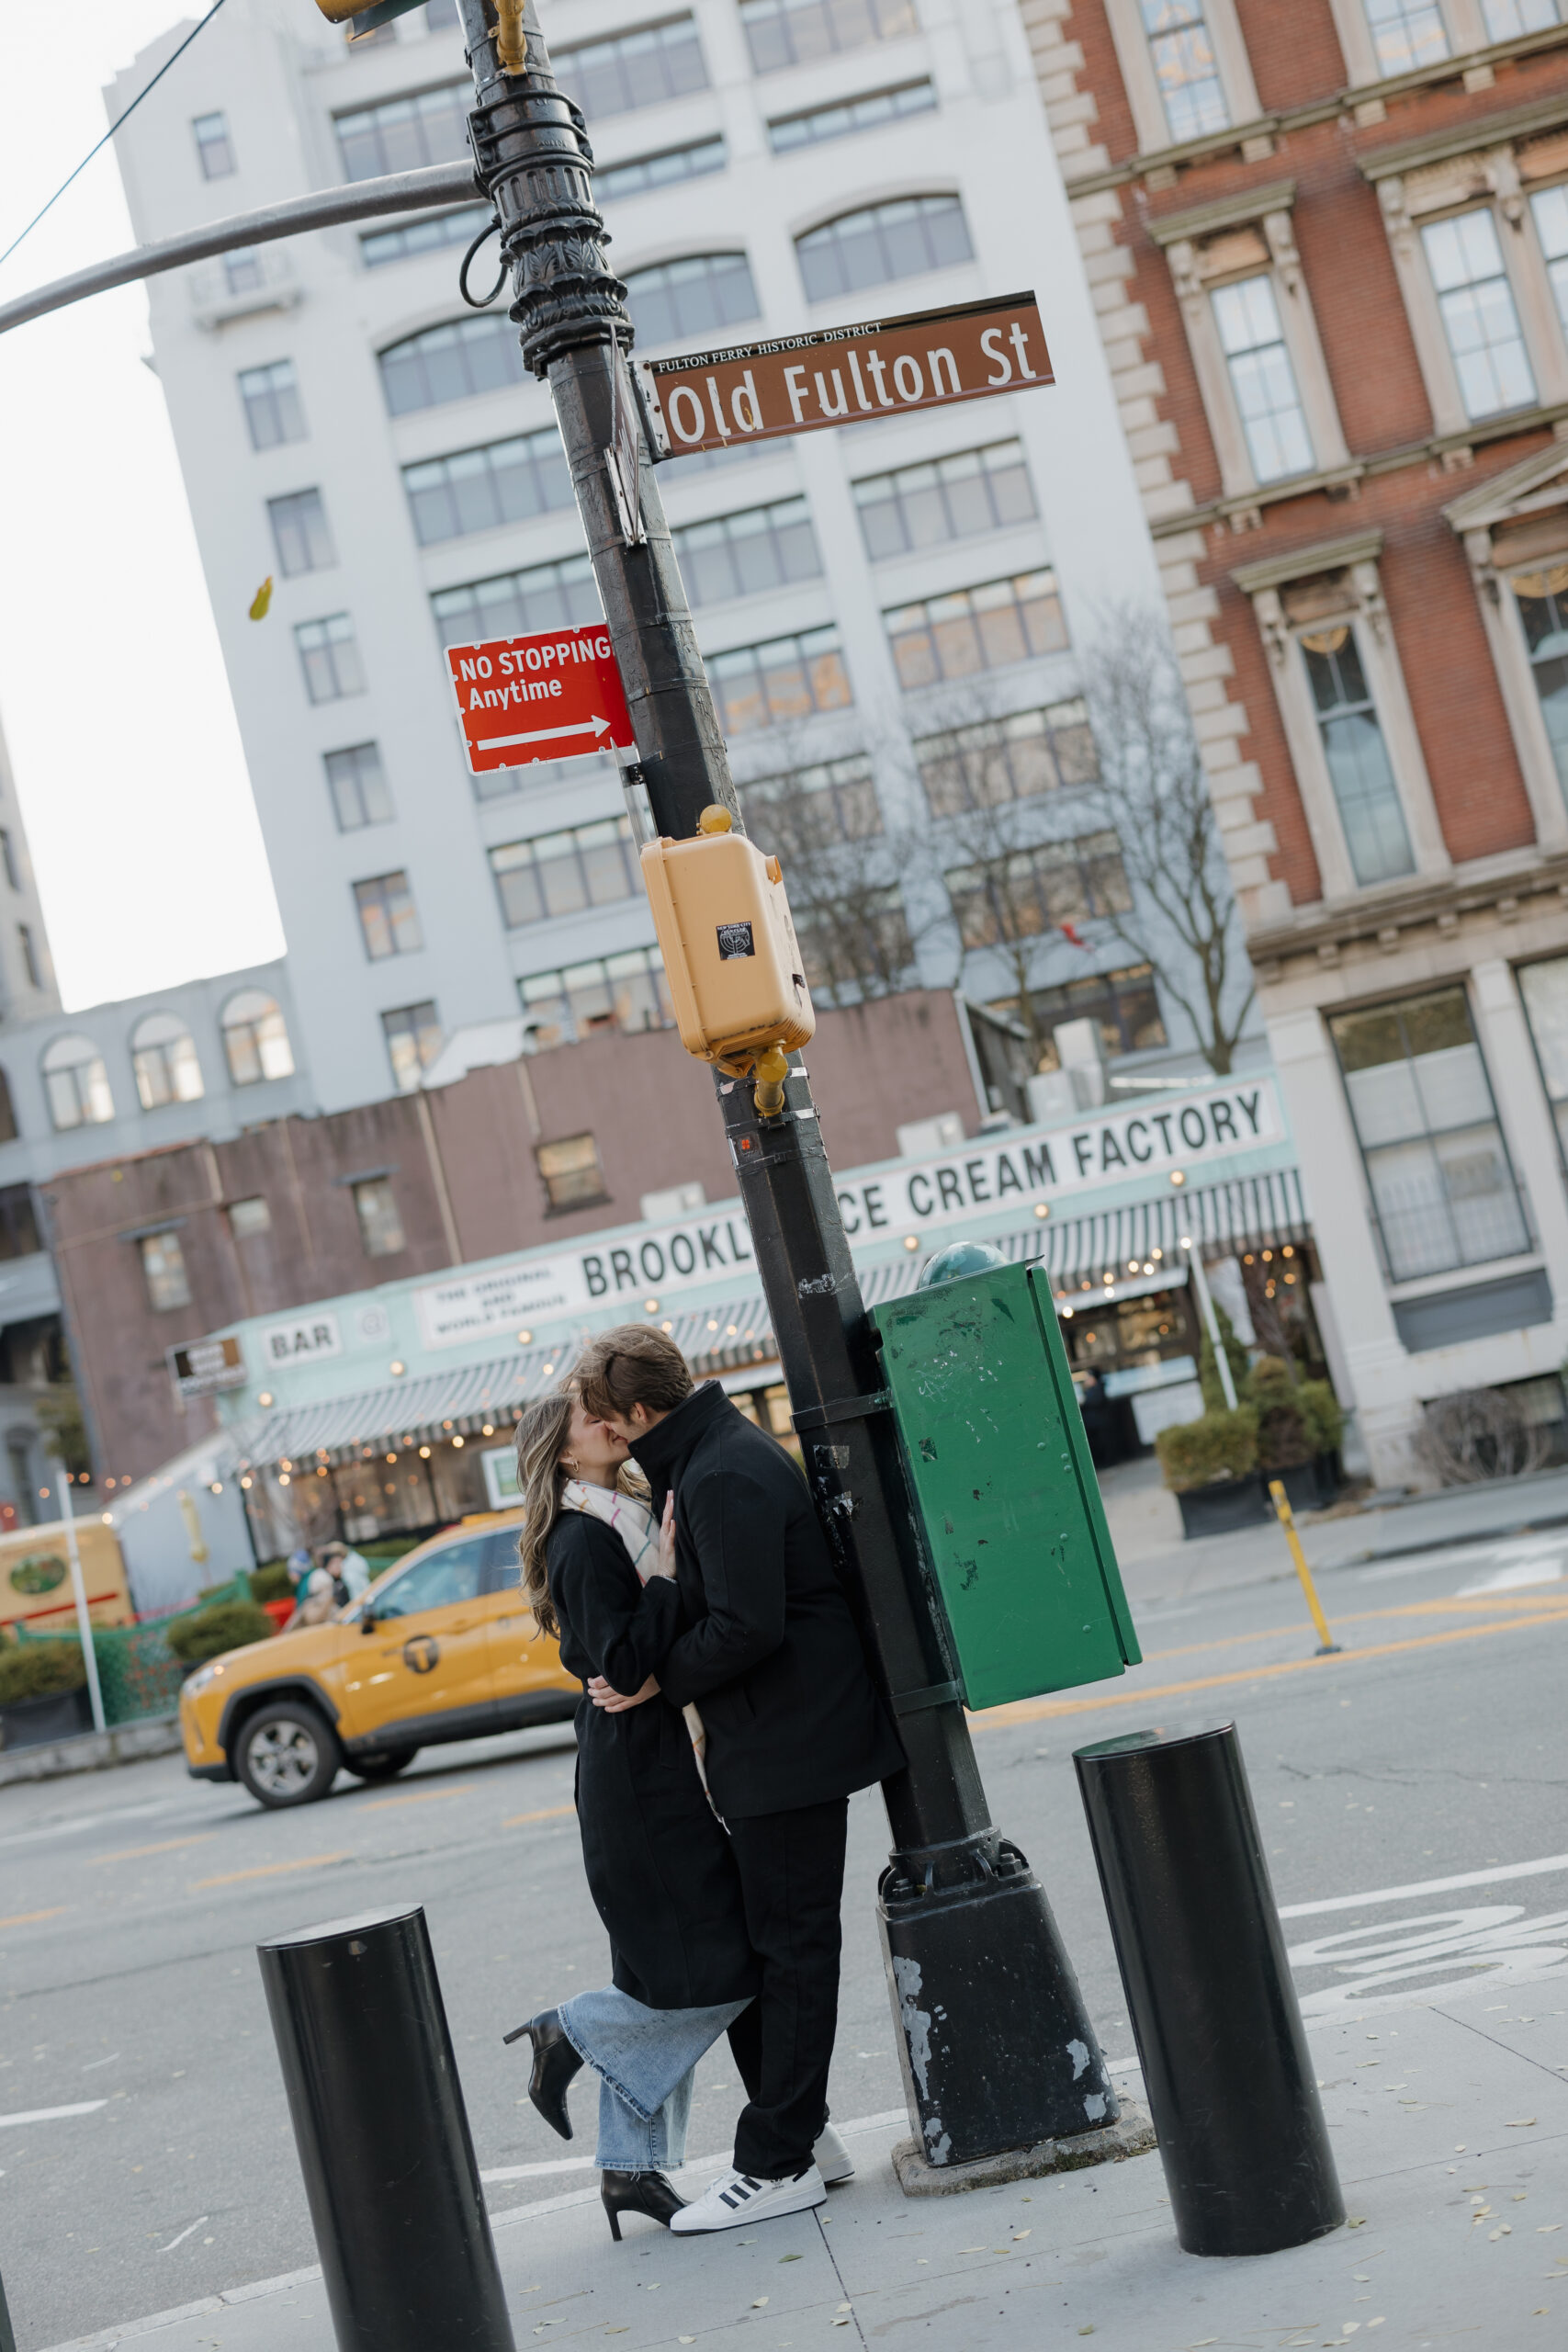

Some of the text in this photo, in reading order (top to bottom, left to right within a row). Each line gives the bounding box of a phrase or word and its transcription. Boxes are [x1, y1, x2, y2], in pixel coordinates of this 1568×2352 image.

[658, 322, 882, 374] FULTON FERRY HISTORIC DISTRICT
[668, 322, 1037, 444] Old Fulton St
[459, 636, 611, 682] NO STOPPING
[469, 678, 563, 711] Anytime
[582, 1091, 1263, 1297] BROOKL CE CREAM FACTORY
[271, 1324, 333, 1360] BAR
